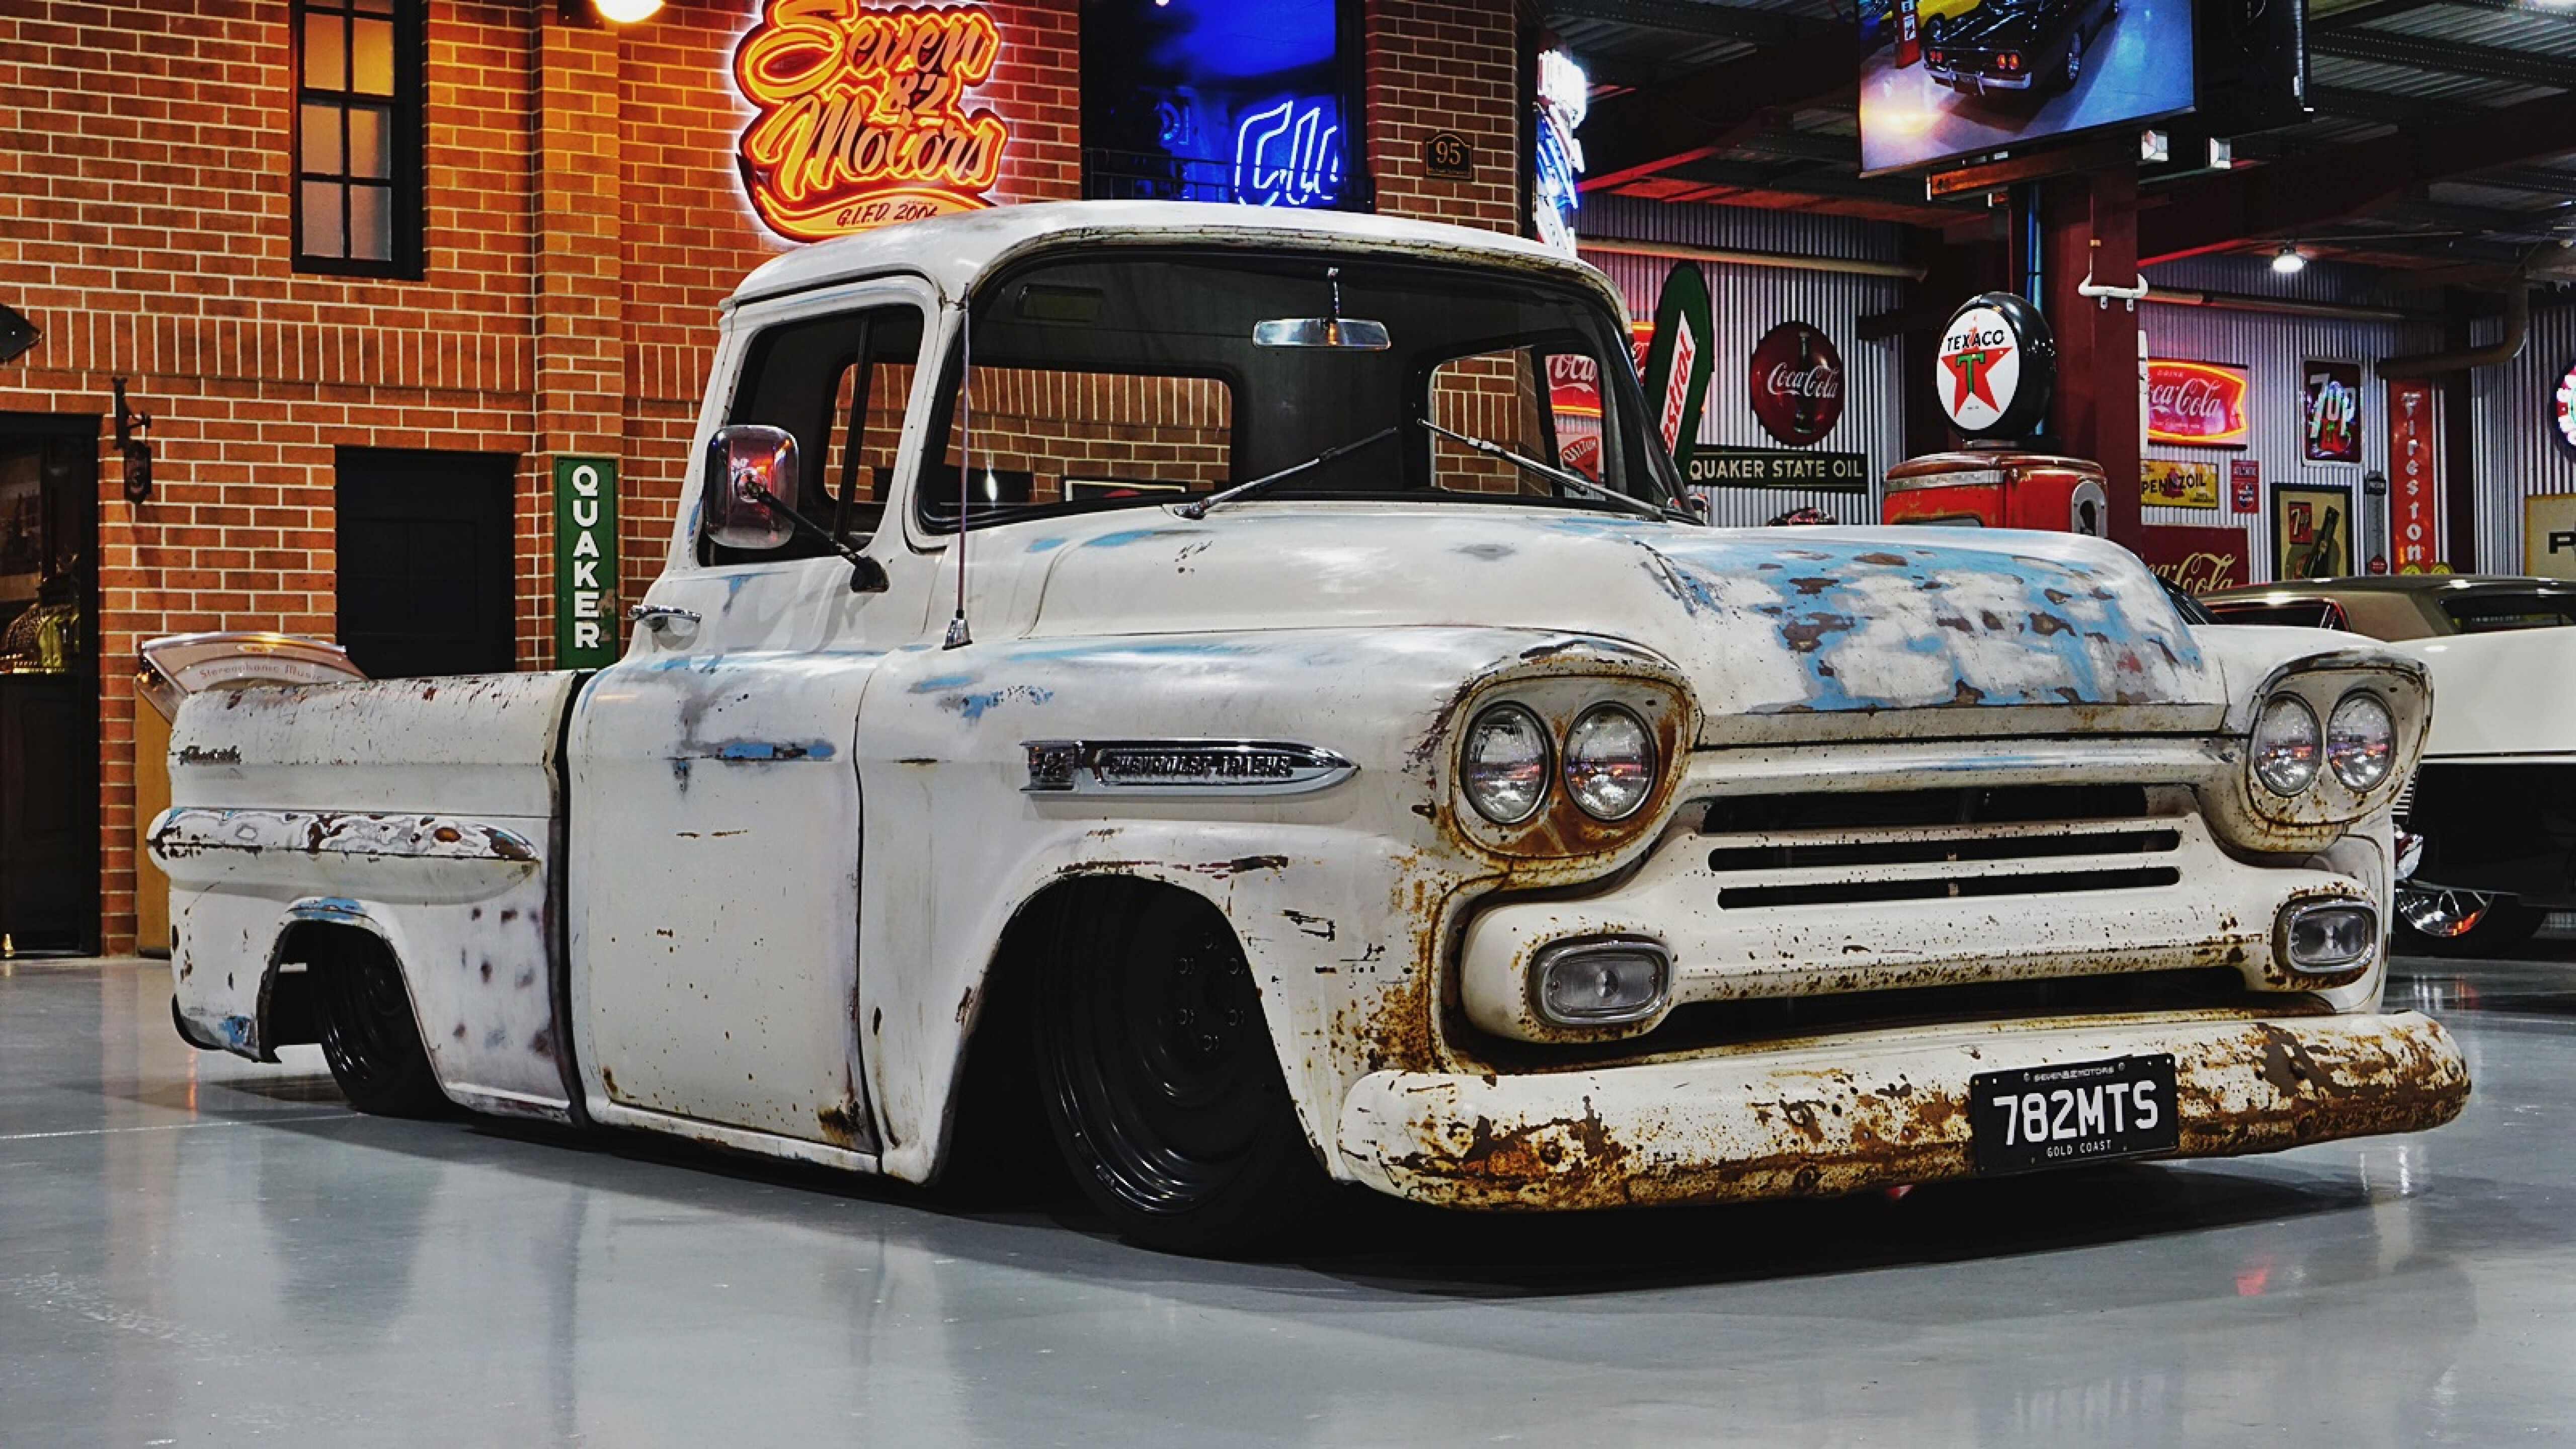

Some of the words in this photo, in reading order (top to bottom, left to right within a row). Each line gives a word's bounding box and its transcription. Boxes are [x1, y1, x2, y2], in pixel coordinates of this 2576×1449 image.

[745, 0, 992, 100] Seven
[879, 73, 950, 116] 82
[756, 93, 996, 199] Motors
[1435, 141, 1461, 165] 95
[1947, 330, 2005, 352] TEXACO
[1662, 329, 1693, 457] astrol
[1689, 459, 1764, 480] QUAKER
[1772, 460, 1826, 478] STATE
[1833, 460, 1864, 478] OIL
[2400, 391, 2423, 561] Fireston
[572, 465, 600, 649] QUAKER
[1993, 1080, 2158, 1145] 782MTS
[2047, 1146, 2073, 1158] GOLD
[2079, 1139, 2112, 1153] COAST
